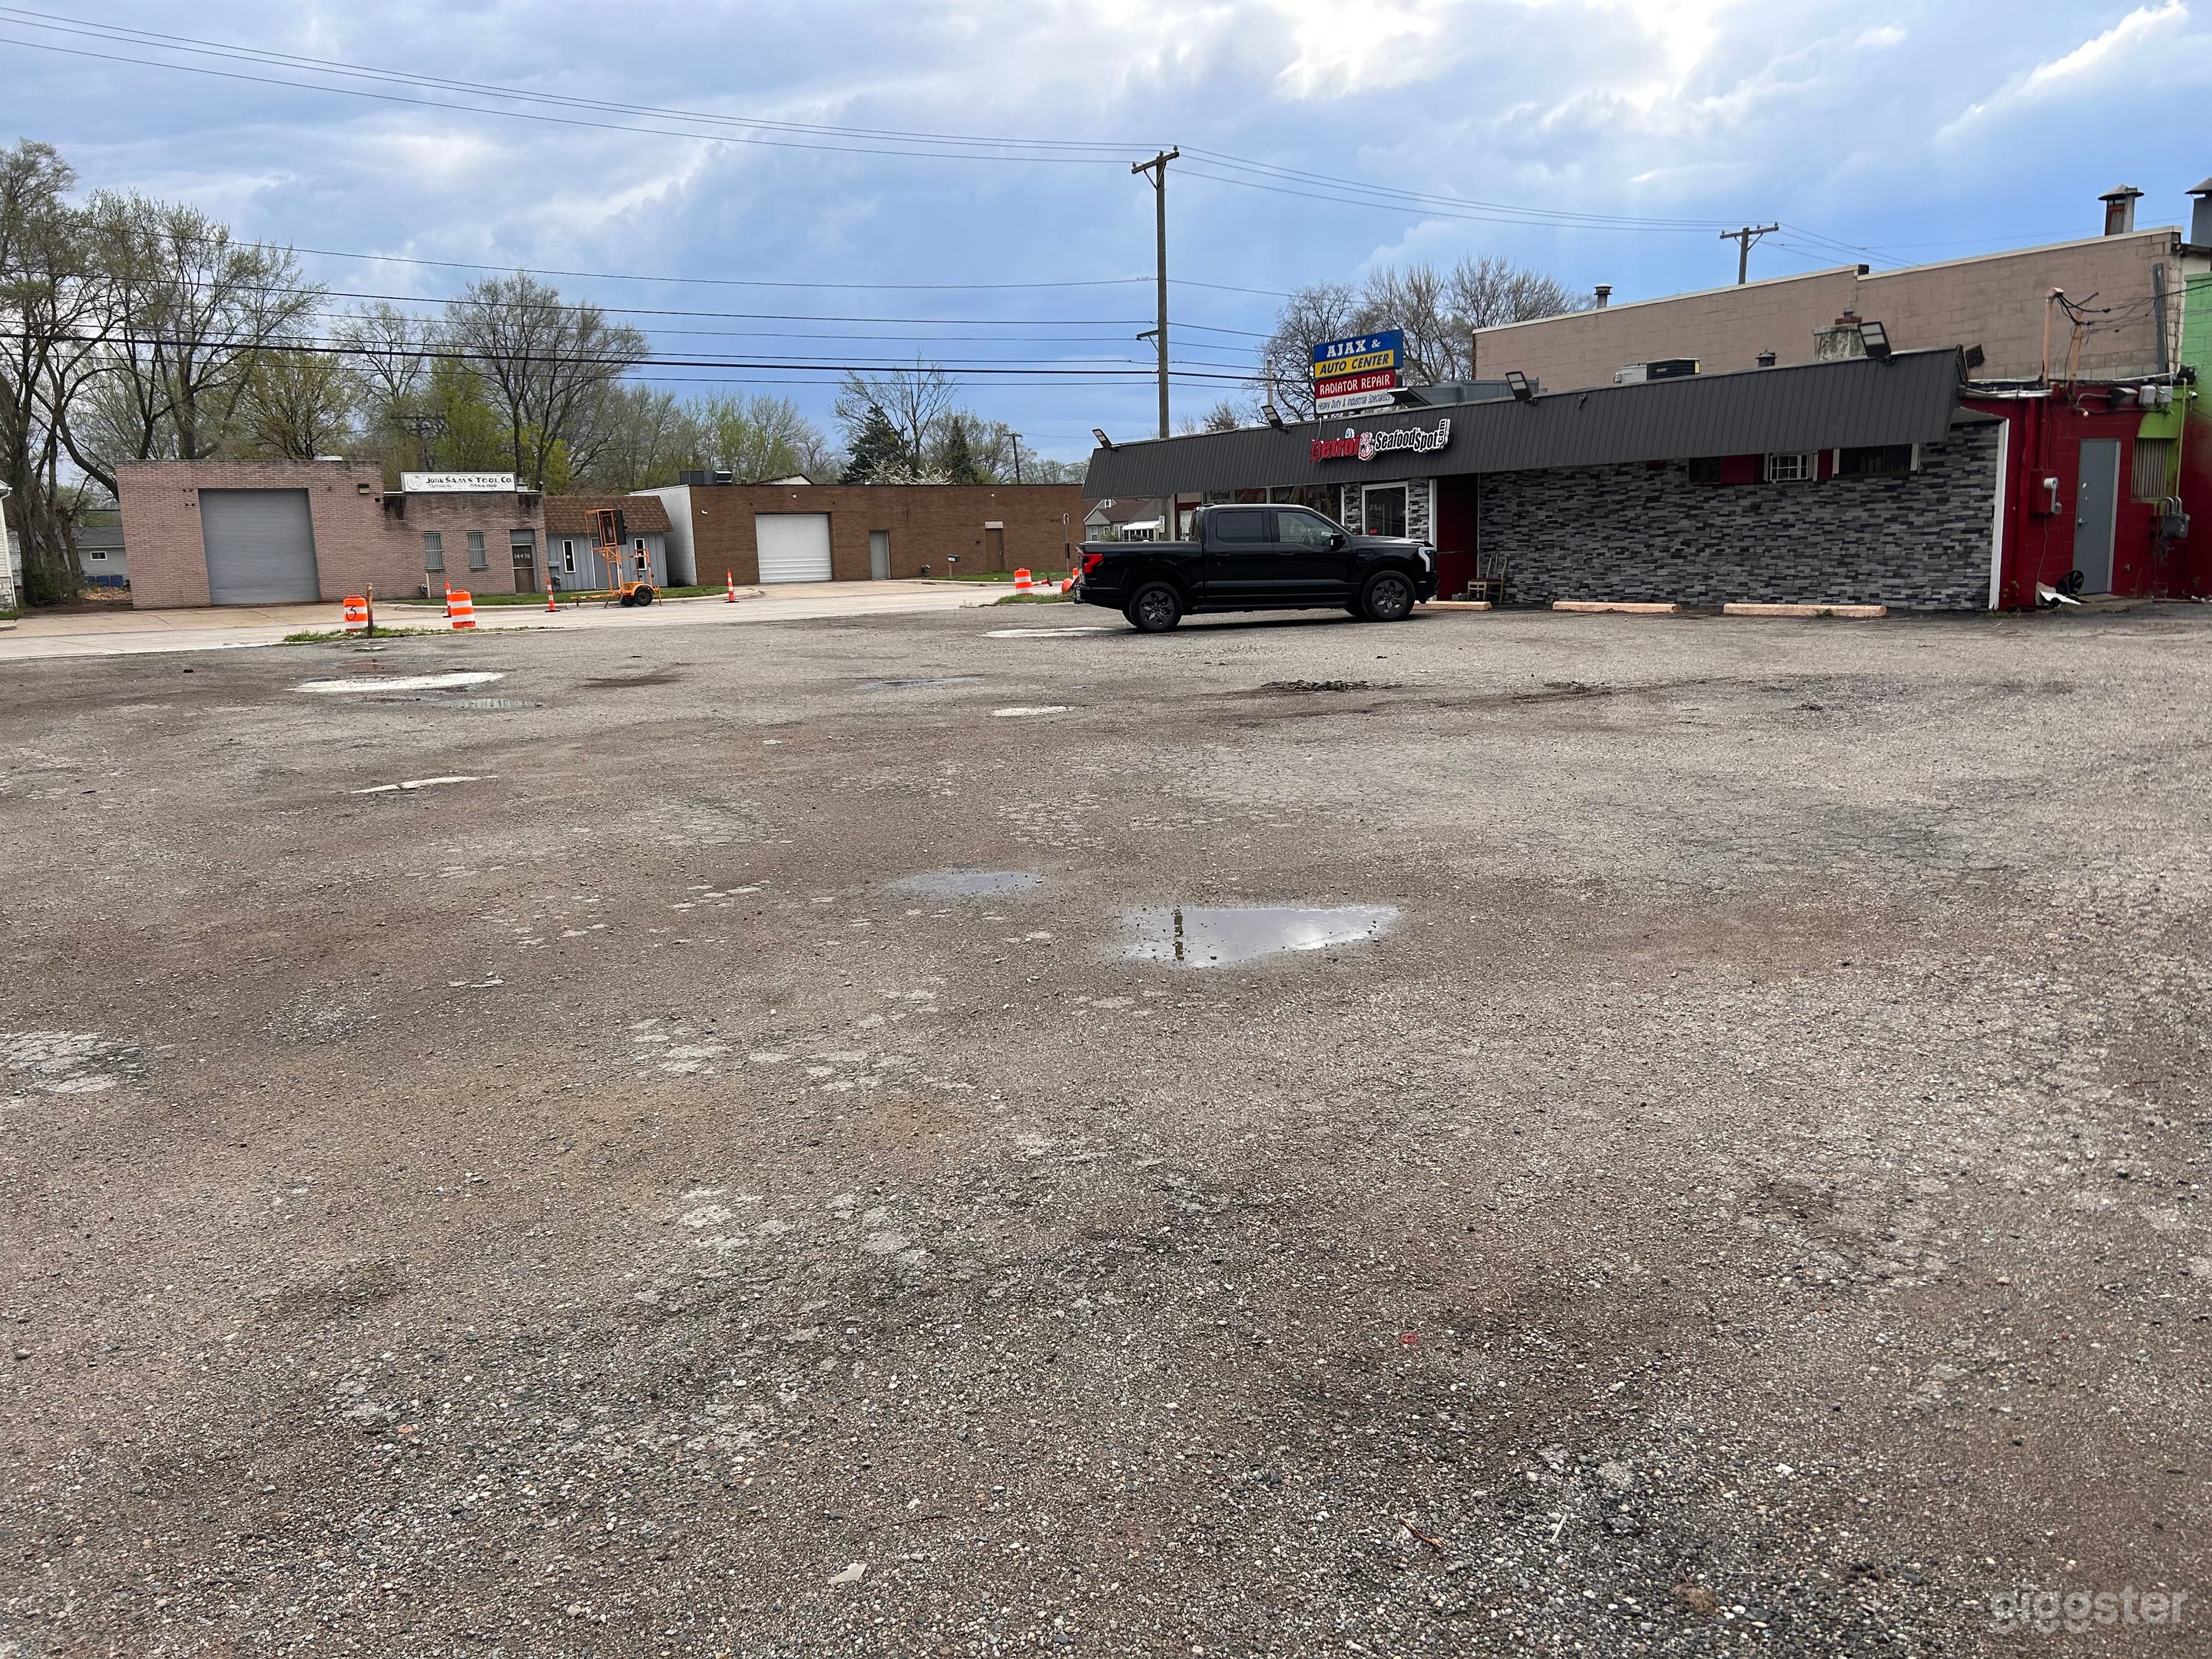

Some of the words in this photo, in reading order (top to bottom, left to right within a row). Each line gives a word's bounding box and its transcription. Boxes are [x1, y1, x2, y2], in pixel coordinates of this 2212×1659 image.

[1326, 339, 1366, 358] AJAX
[1371, 339, 1381, 349] &
[1320, 360, 1347, 375] AUTO
[1352, 353, 1389, 369] CENTER
[1320, 379, 1358, 396] RADIATOR
[1361, 374, 1390, 389] REPAIR
[1317, 402, 1331, 411] Heavy
[1331, 399, 1342, 409] Duty
[1347, 395, 1367, 406] Industrial
[344, 604, 357, 621] 3
